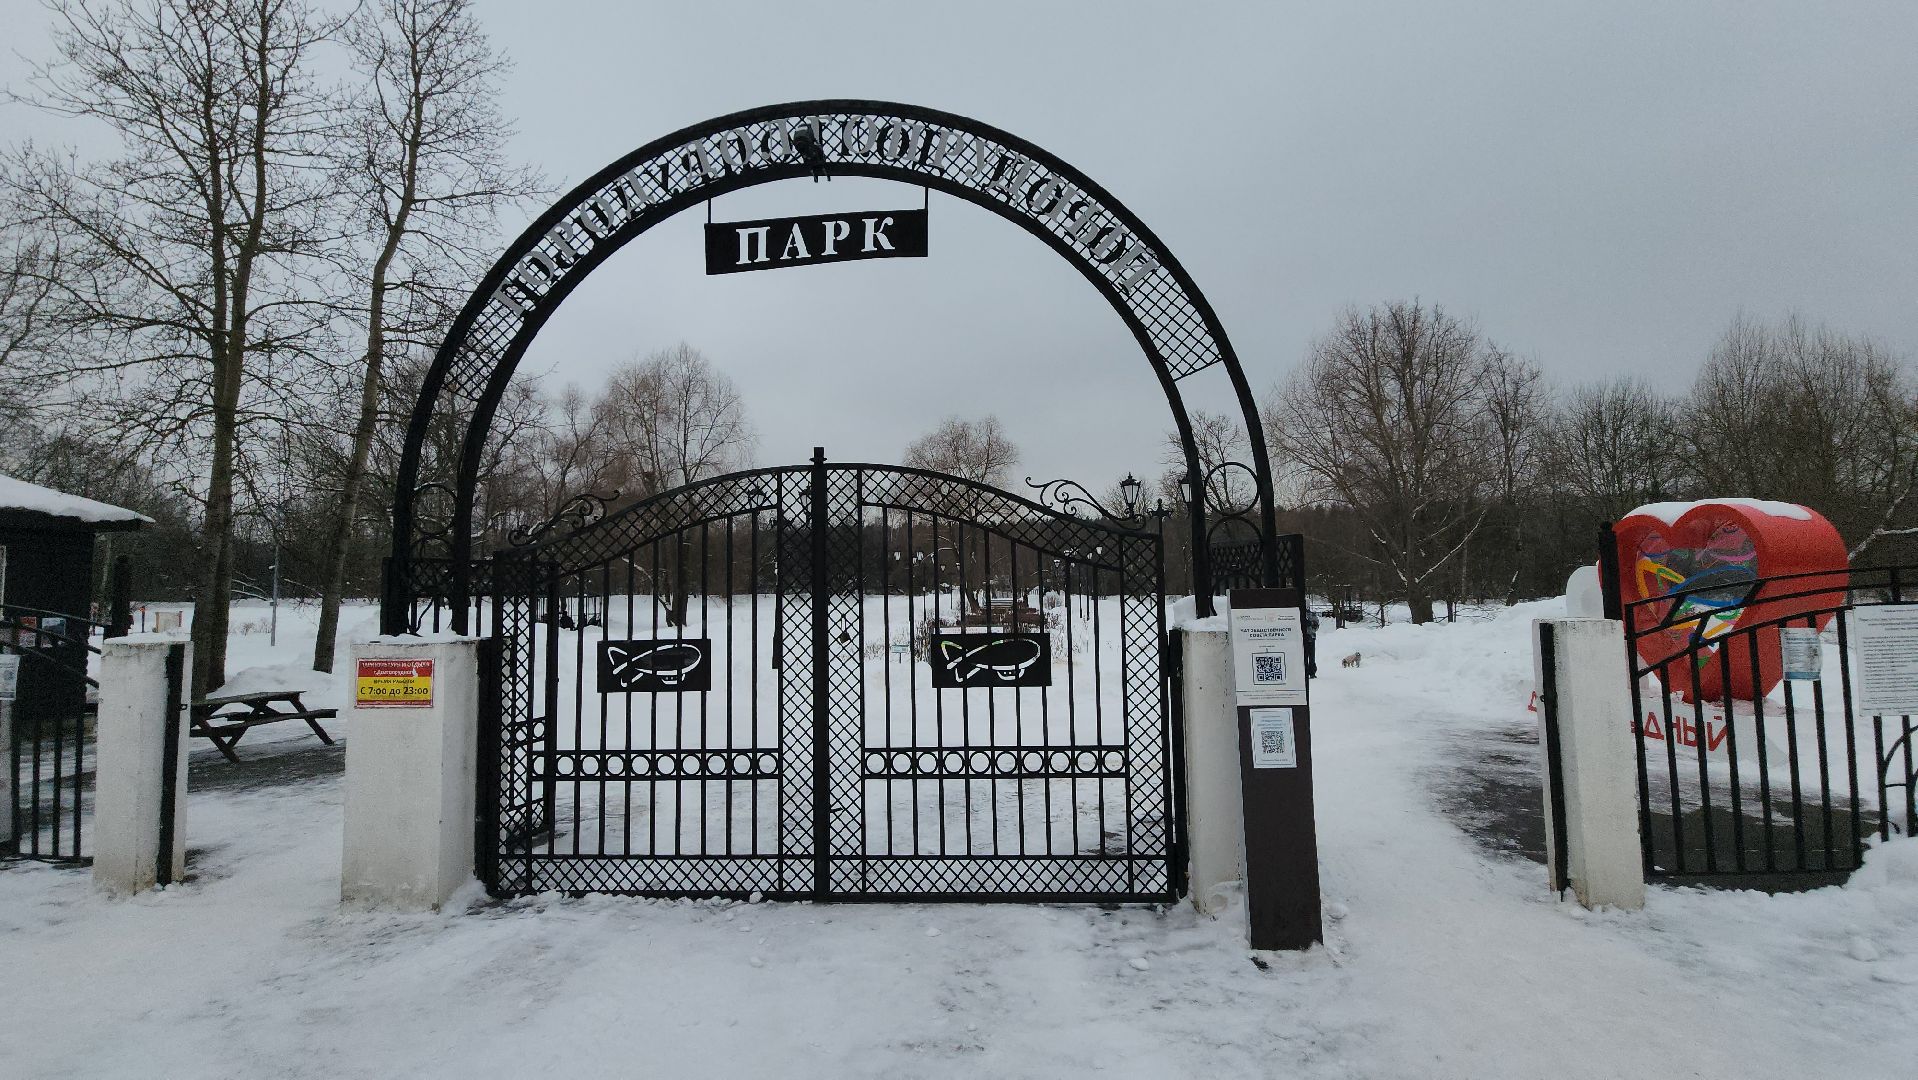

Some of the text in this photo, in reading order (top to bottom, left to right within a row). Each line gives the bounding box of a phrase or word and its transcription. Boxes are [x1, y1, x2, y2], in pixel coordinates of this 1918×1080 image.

[736, 216, 896, 265] ПАРК
[368, 687, 387, 695] 7:00
[388, 688, 401, 697] до
[403, 686, 429, 695] 23:00
